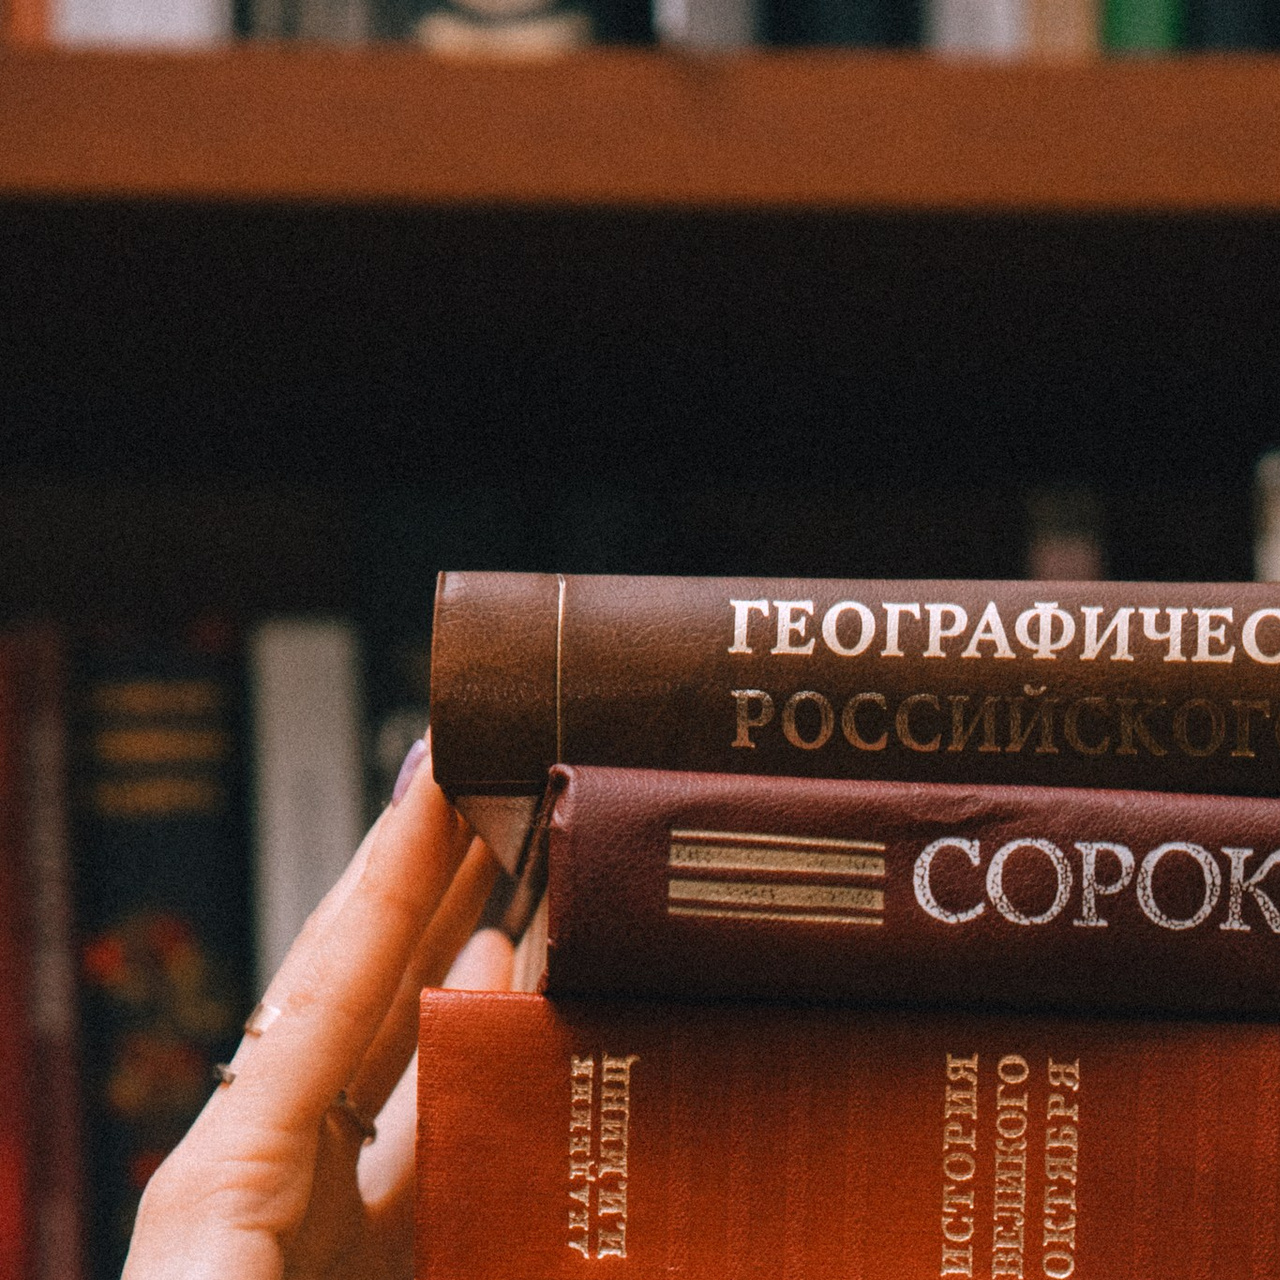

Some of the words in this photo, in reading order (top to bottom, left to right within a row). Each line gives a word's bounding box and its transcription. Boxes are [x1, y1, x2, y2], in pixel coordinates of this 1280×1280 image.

[567, 1053, 597, 1260] АКАДЕМИК
[940, 1053, 980, 1279] ИСТОРИЯ
[990, 1053, 1030, 1280] ВЕЛИКОГО
[1042, 1056, 1081, 1280] ОКТЯБРЯ
